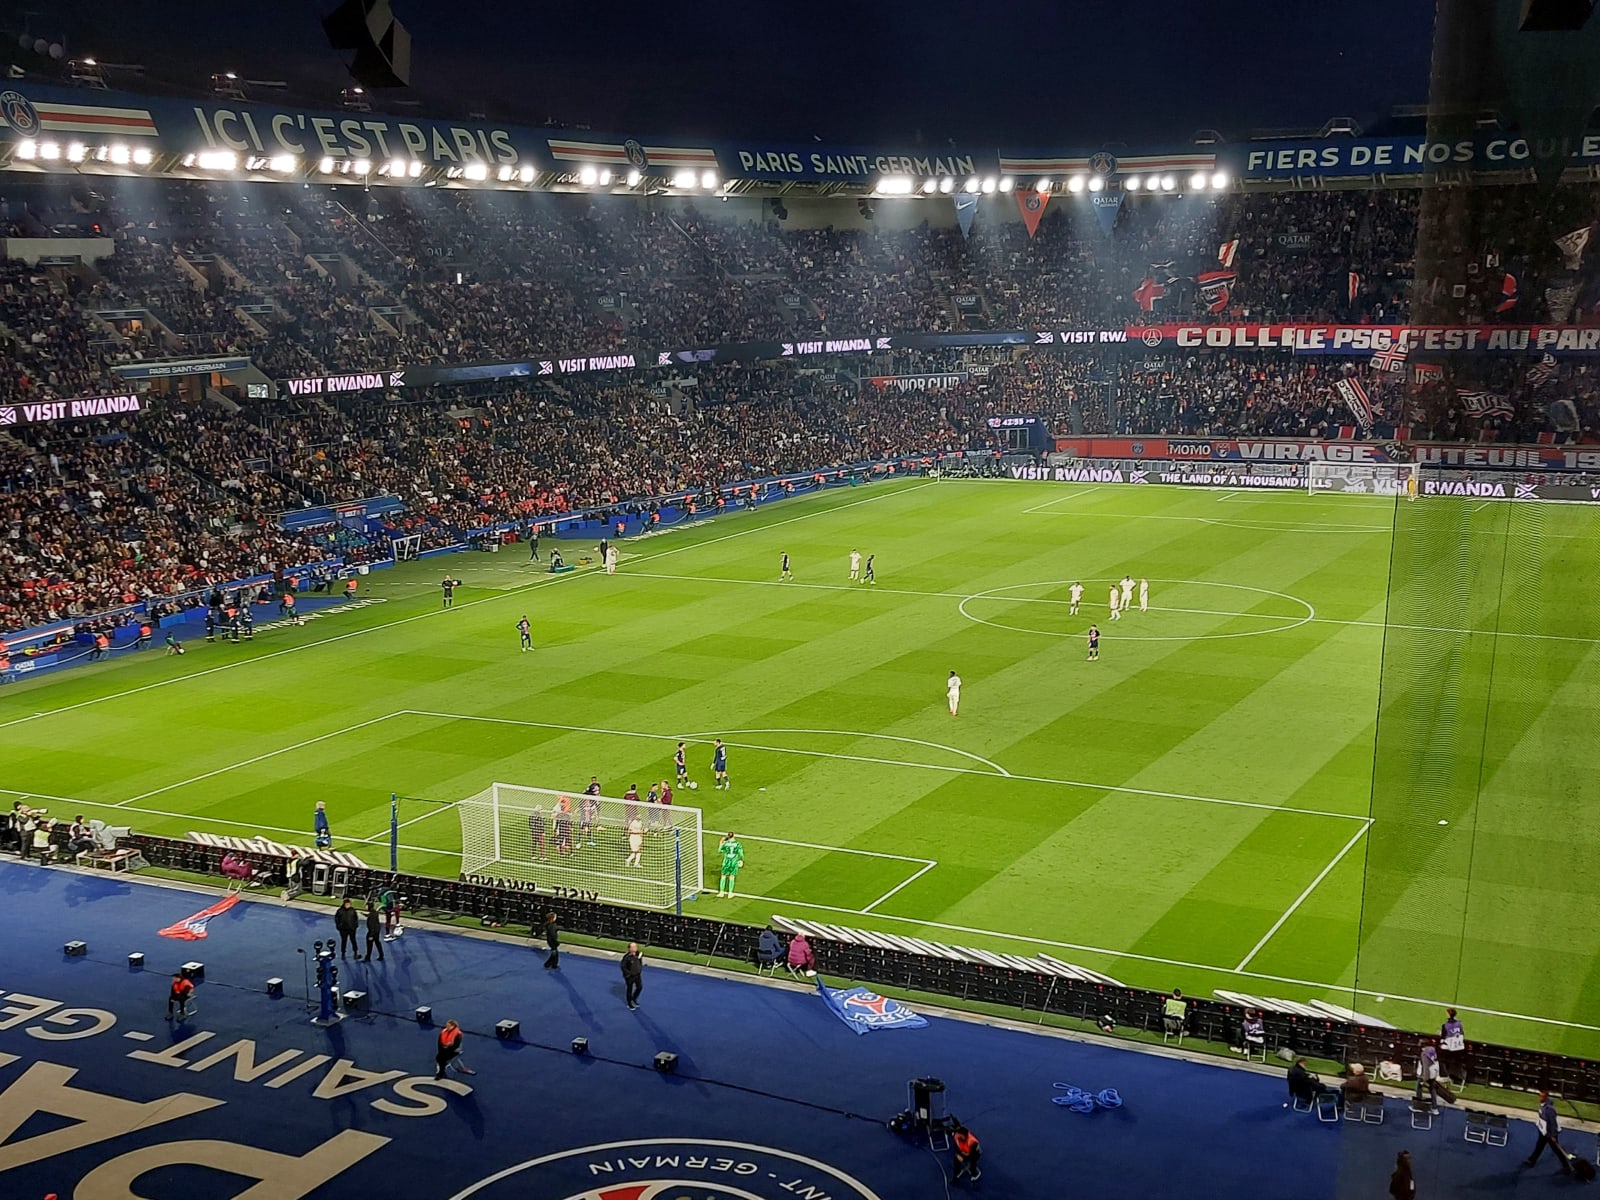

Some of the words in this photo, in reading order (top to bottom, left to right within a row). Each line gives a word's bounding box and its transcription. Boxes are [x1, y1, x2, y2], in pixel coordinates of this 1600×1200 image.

[193, 107, 264, 151] ICI
[272, 114, 391, 158] C'EST
[398, 123, 519, 165] PARIS
[739, 151, 803, 173] PARIS
[811, 153, 976, 177] SAINT-GERMAIN
[1248, 147, 1339, 171] FIERS
[1350, 145, 1393, 166] DE
[1403, 141, 1474, 164] NOS
[1485, 136, 1600, 161] COE
[796, 341, 823, 354] VISIT
[825, 338, 872, 352] RWANDA
[1060, 331, 1096, 343] VISIT
[1295, 328, 1328, 349] LE
[1333, 328, 1391, 350] PSG
[1399, 329, 1483, 351] C'EST
[1487, 329, 1531, 350] AU
[558, 358, 587, 373] VISIT
[589, 354, 636, 370] RWANDA
[288, 379, 323, 395] VISIT
[327, 374, 384, 392] RWANDA
[23, 402, 66, 422] VISIT
[71, 395, 140, 417] RWANDA
[1169, 443, 1211, 455] MOMO
[1238, 443, 1376, 462] VIRAGE
[1416, 447, 1548, 467] UTEUIL
[1011, 467, 1050, 480] VISIT
[1055, 467, 1123, 483] RWANDA
[1160, 473, 1180, 483] THE
[1181, 474, 1212, 484] LAND
[1213, 475, 1226, 484] OF
[1229, 475, 1238, 485] A
[1239, 475, 1299, 487] THOUSAND
[1300, 477, 1333, 488] HLLS
[1424, 481, 1506, 497] RWANDA
[0, 988, 473, 1116] SAINT-GE
